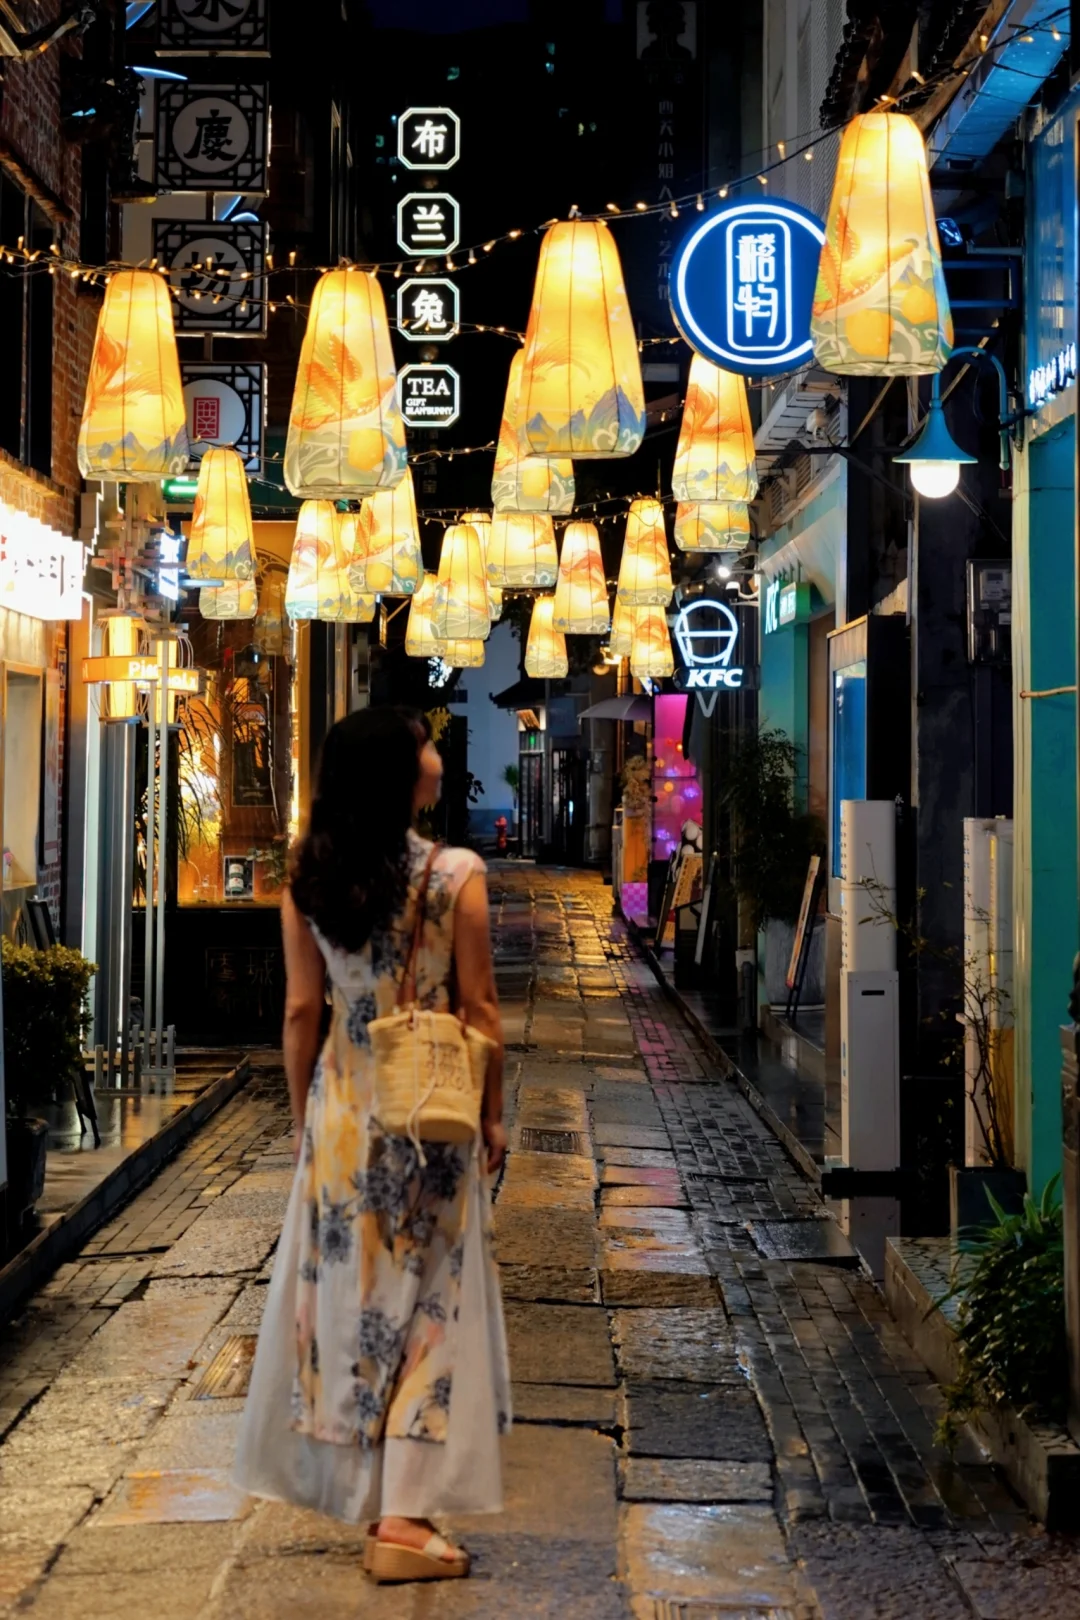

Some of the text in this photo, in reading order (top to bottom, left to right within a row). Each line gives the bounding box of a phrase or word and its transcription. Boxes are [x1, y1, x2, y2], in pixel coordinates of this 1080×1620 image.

[411, 120, 447, 331] 布兰兔
[406, 377, 451, 396] TEA
[405, 397, 427, 407] GIFT
[686, 668, 744, 688] KFC
